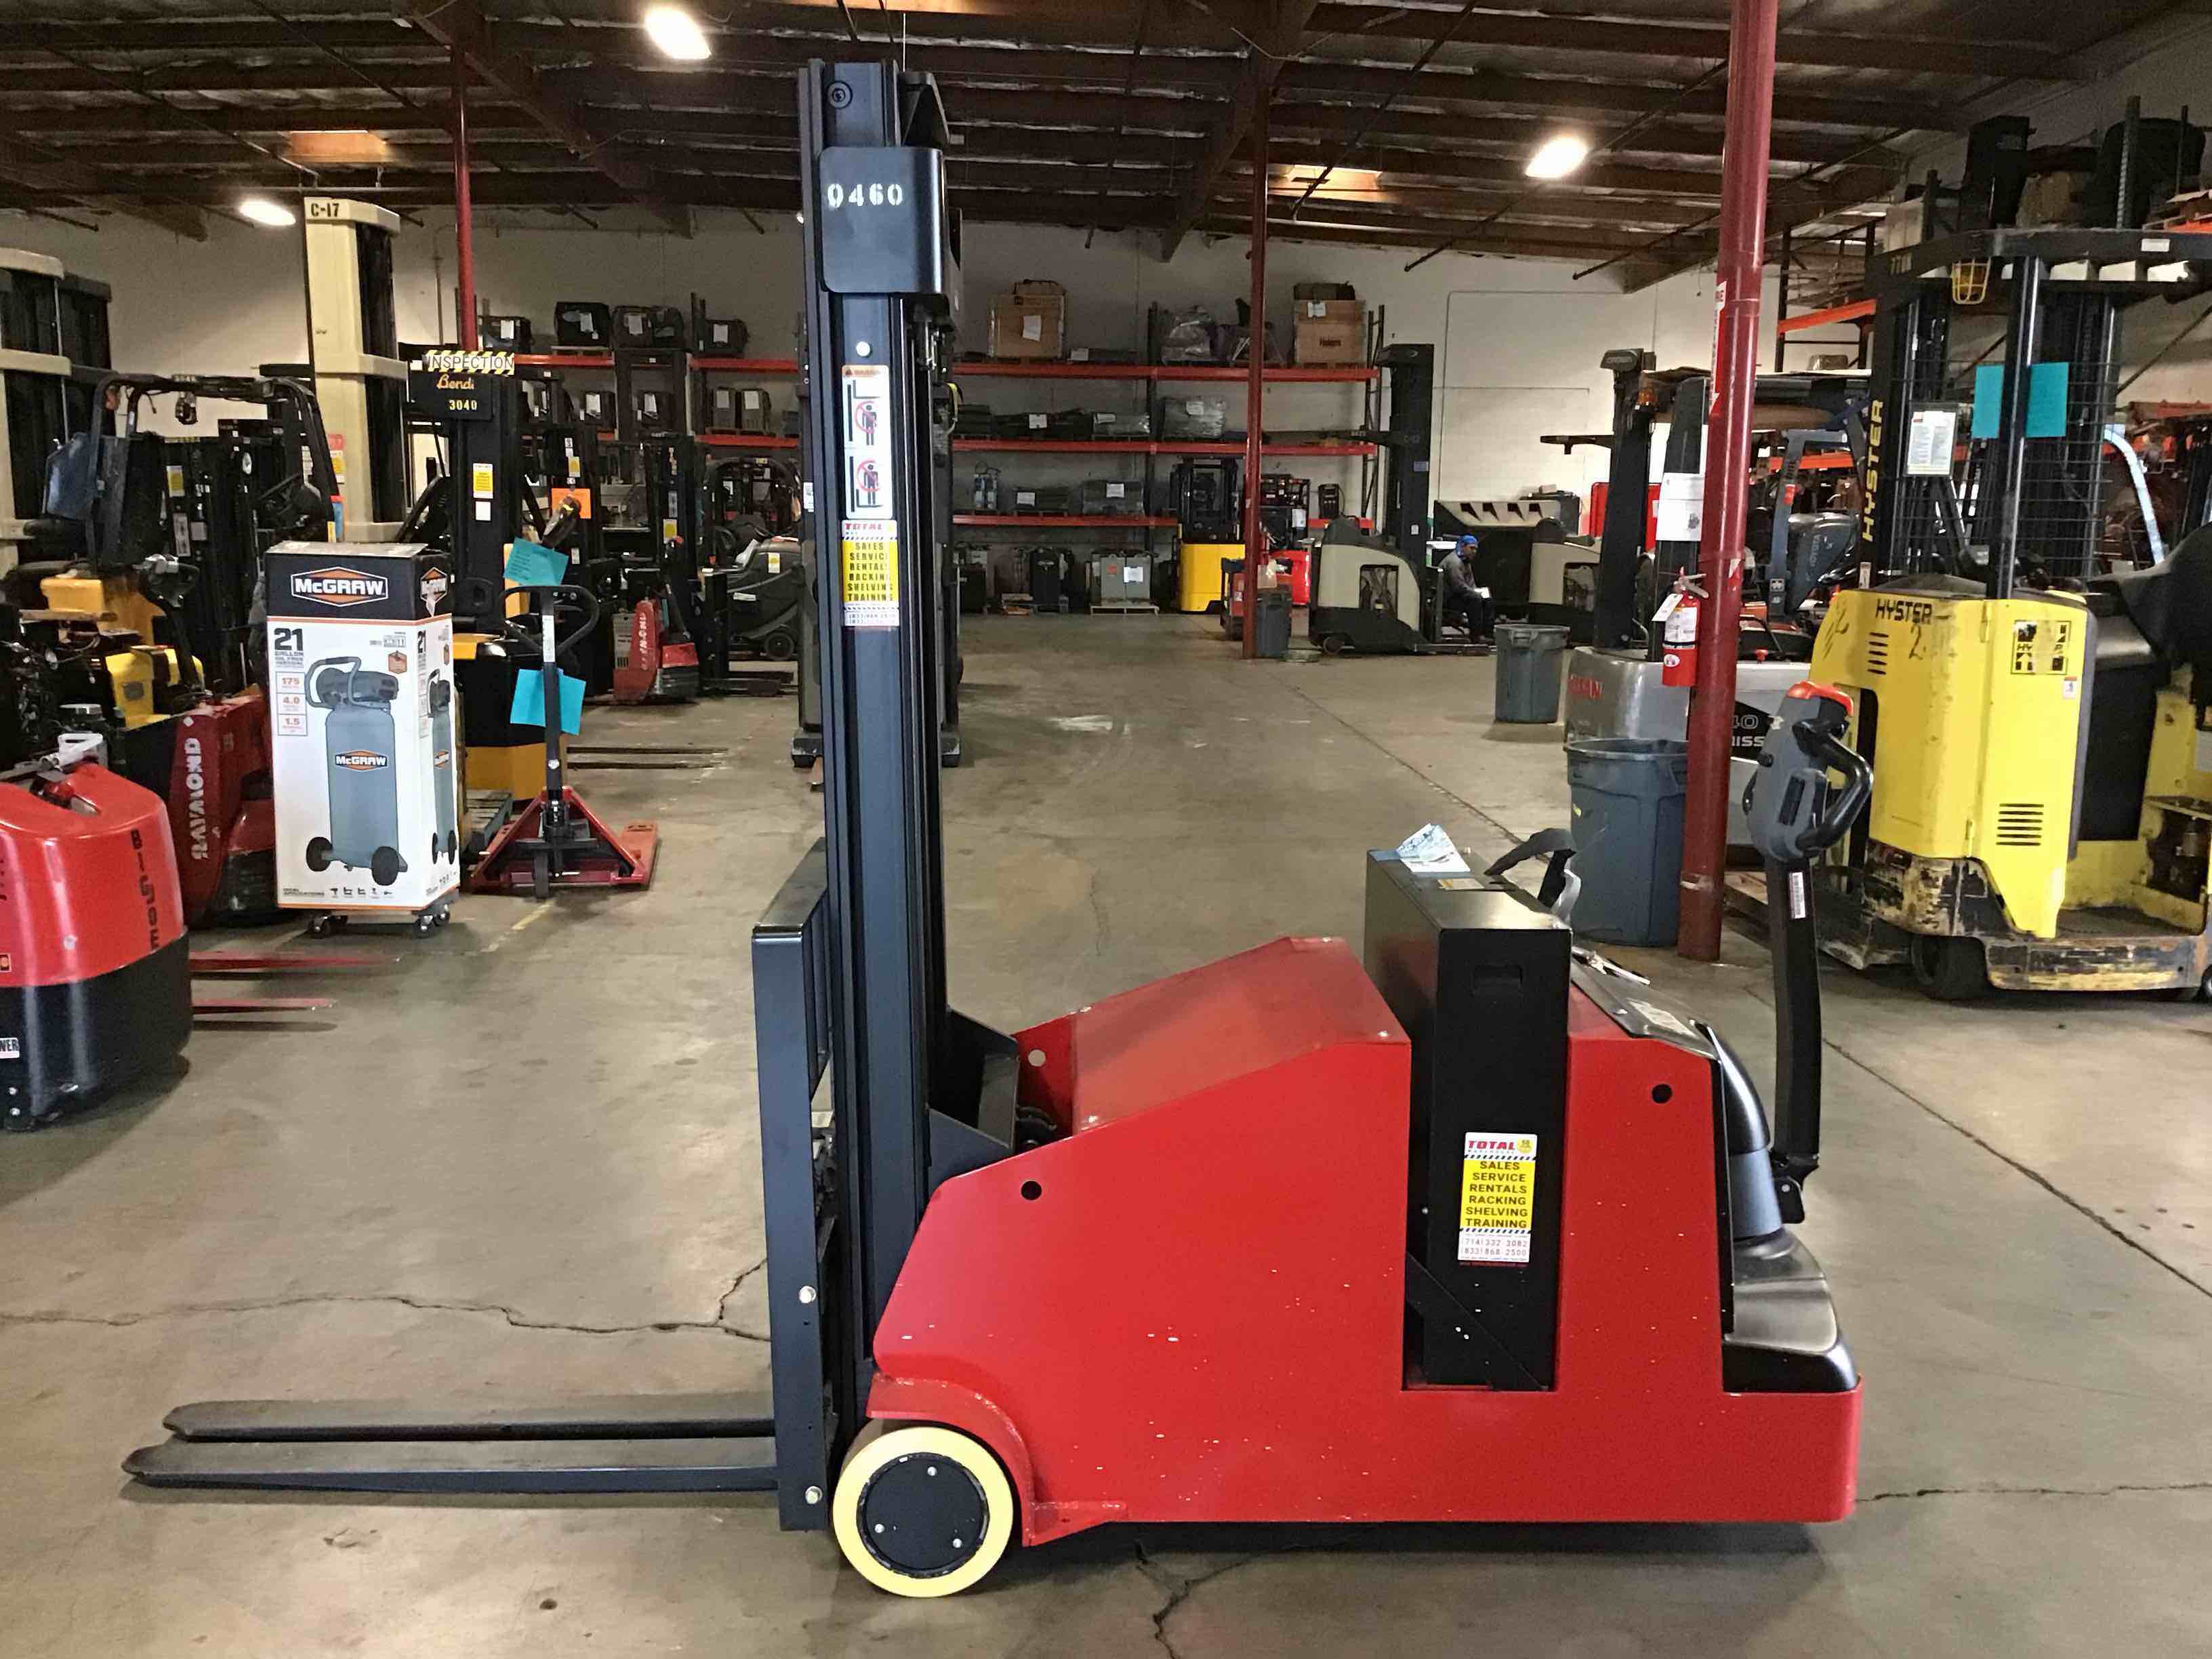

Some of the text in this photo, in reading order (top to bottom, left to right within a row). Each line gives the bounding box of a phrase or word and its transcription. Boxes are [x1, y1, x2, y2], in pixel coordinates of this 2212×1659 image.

[827, 183, 903, 208] 0460
[310, 203, 340, 217] C-17
[428, 355, 514, 370] INSPECTION
[436, 373, 476, 390] Bendi
[449, 399, 478, 411] 3040
[1862, 399, 1884, 542] HYSTER
[855, 542, 884, 551] SALES
[849, 552, 888, 560] SERVIC
[848, 573, 891, 581] RACKIN
[295, 578, 385, 596] McGRAW
[1875, 598, 1932, 624] HYSTER
[274, 628, 304, 651] 21
[1732, 735, 1765, 746] ISS
[335, 756, 386, 766] McGRAW
[1468, 1140, 1515, 1150] TOTAL
[1479, 1161, 1521, 1170] SALES
[1473, 1172, 1526, 1183] SERVICE
[1469, 1183, 1528, 1194] RENTALS
[1469, 1195, 1527, 1206] RACKING
[1465, 1206, 1528, 1217] SHELVING
[1465, 1218, 1528, 1229] TRAINING
